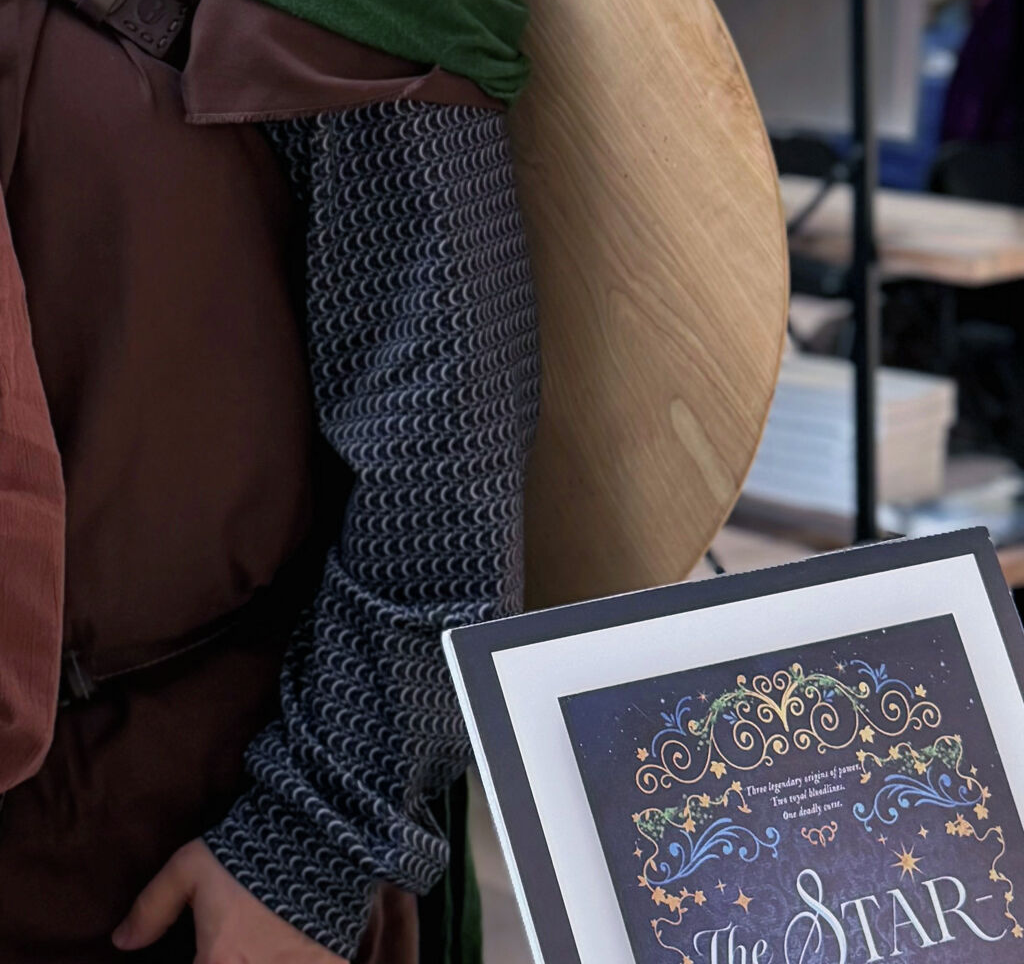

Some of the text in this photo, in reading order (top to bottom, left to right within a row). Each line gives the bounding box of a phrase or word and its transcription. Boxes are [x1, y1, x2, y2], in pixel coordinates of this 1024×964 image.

[746, 764, 861, 796] Three legendary origins of power.
[771, 784, 846, 807] Two royal bloodlines.
[782, 800, 843, 820] One deadly curse.
[693, 921, 774, 964] The
